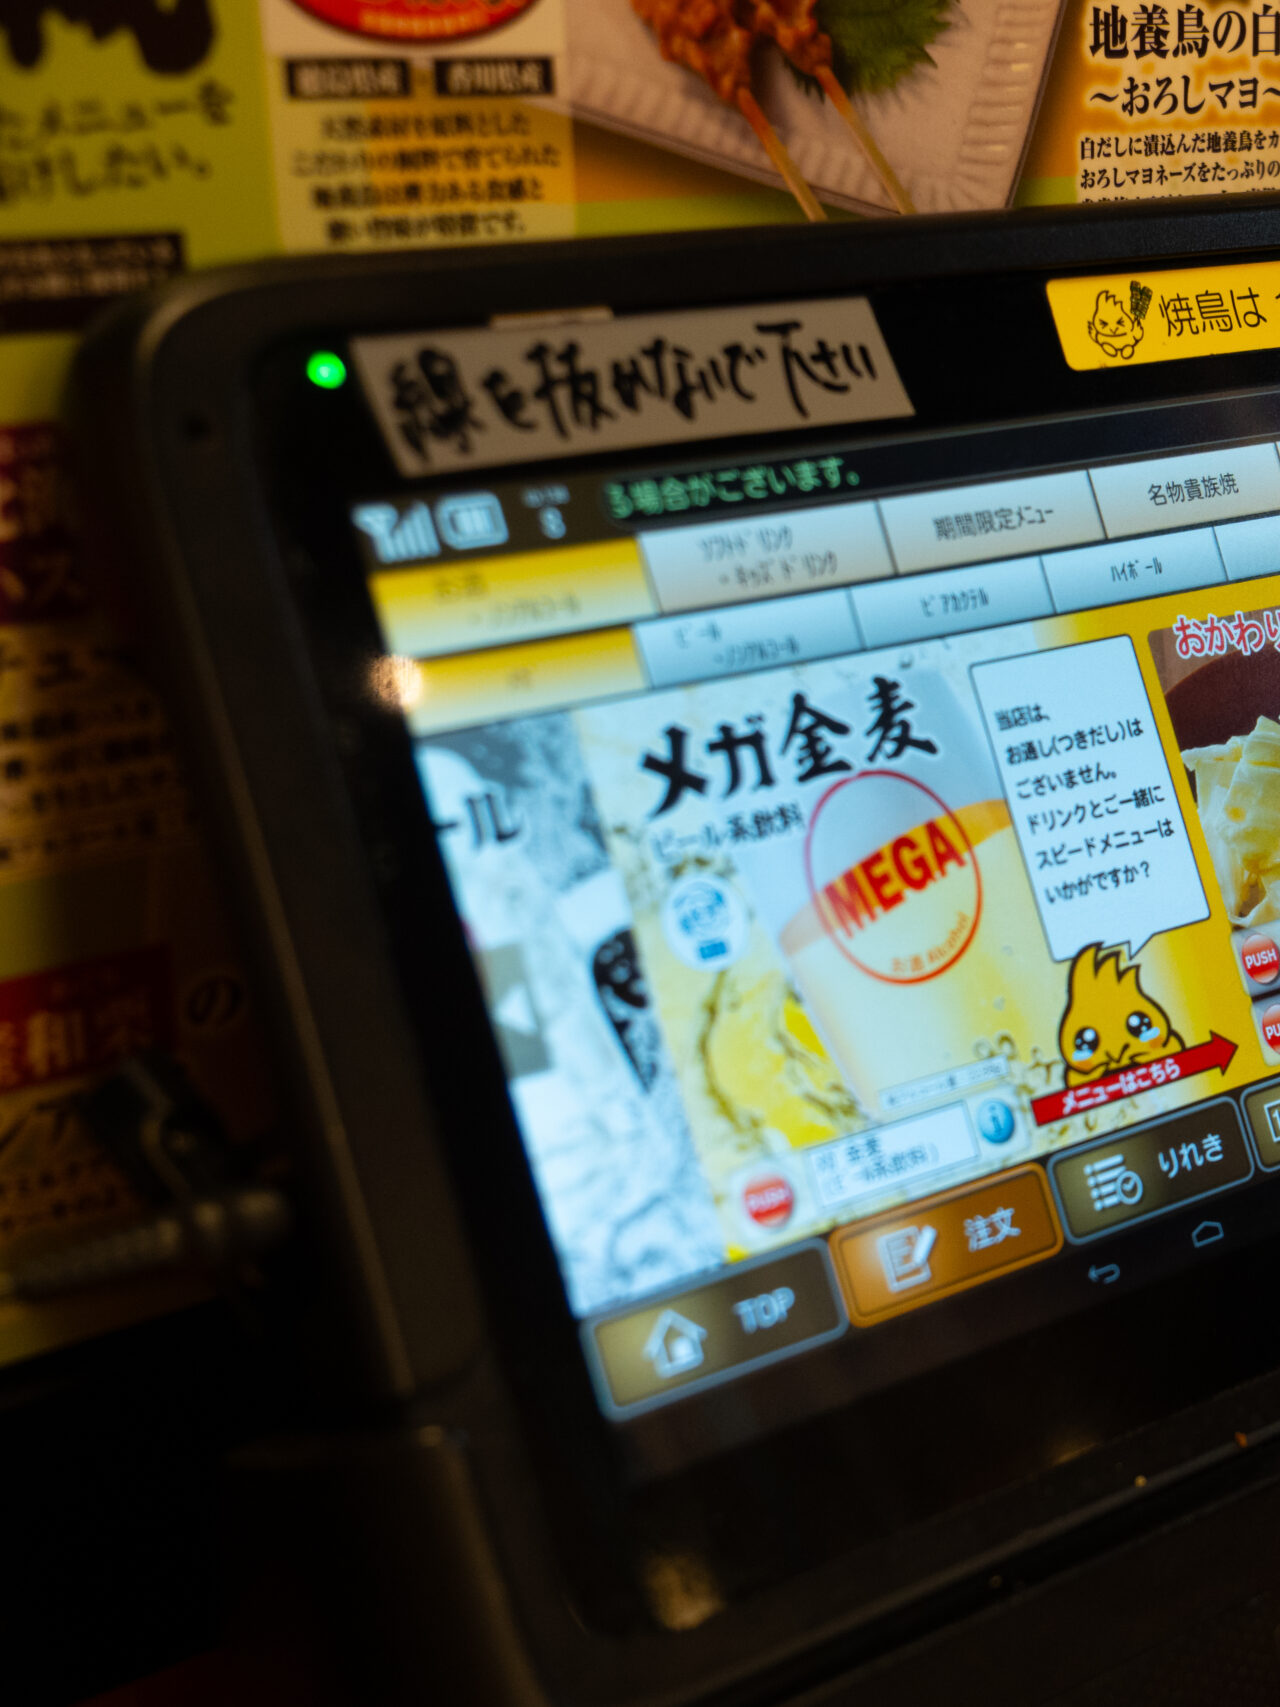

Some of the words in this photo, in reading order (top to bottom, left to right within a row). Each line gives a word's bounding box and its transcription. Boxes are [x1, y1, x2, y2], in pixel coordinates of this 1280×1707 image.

[1146, 473, 1240, 507] 名物貴族焼
[932, 505, 1054, 542] 期間限定メニュー
[1110, 556, 1163, 582] ハイボール
[641, 675, 938, 820] メガ金麦
[1016, 762, 1118, 799] ございません。
[1027, 785, 1166, 835] ドリンクとご一緒に
[1035, 818, 1175, 871] スピードメニューは
[822, 820, 967, 938] MEGA
[1245, 947, 1278, 967] PUSH
[1061, 1056, 1182, 1116] メニューはこちら
[1158, 1133, 1224, 1180] りれき
[964, 1206, 1021, 1252] 注文
[733, 1286, 796, 1334] TOP
